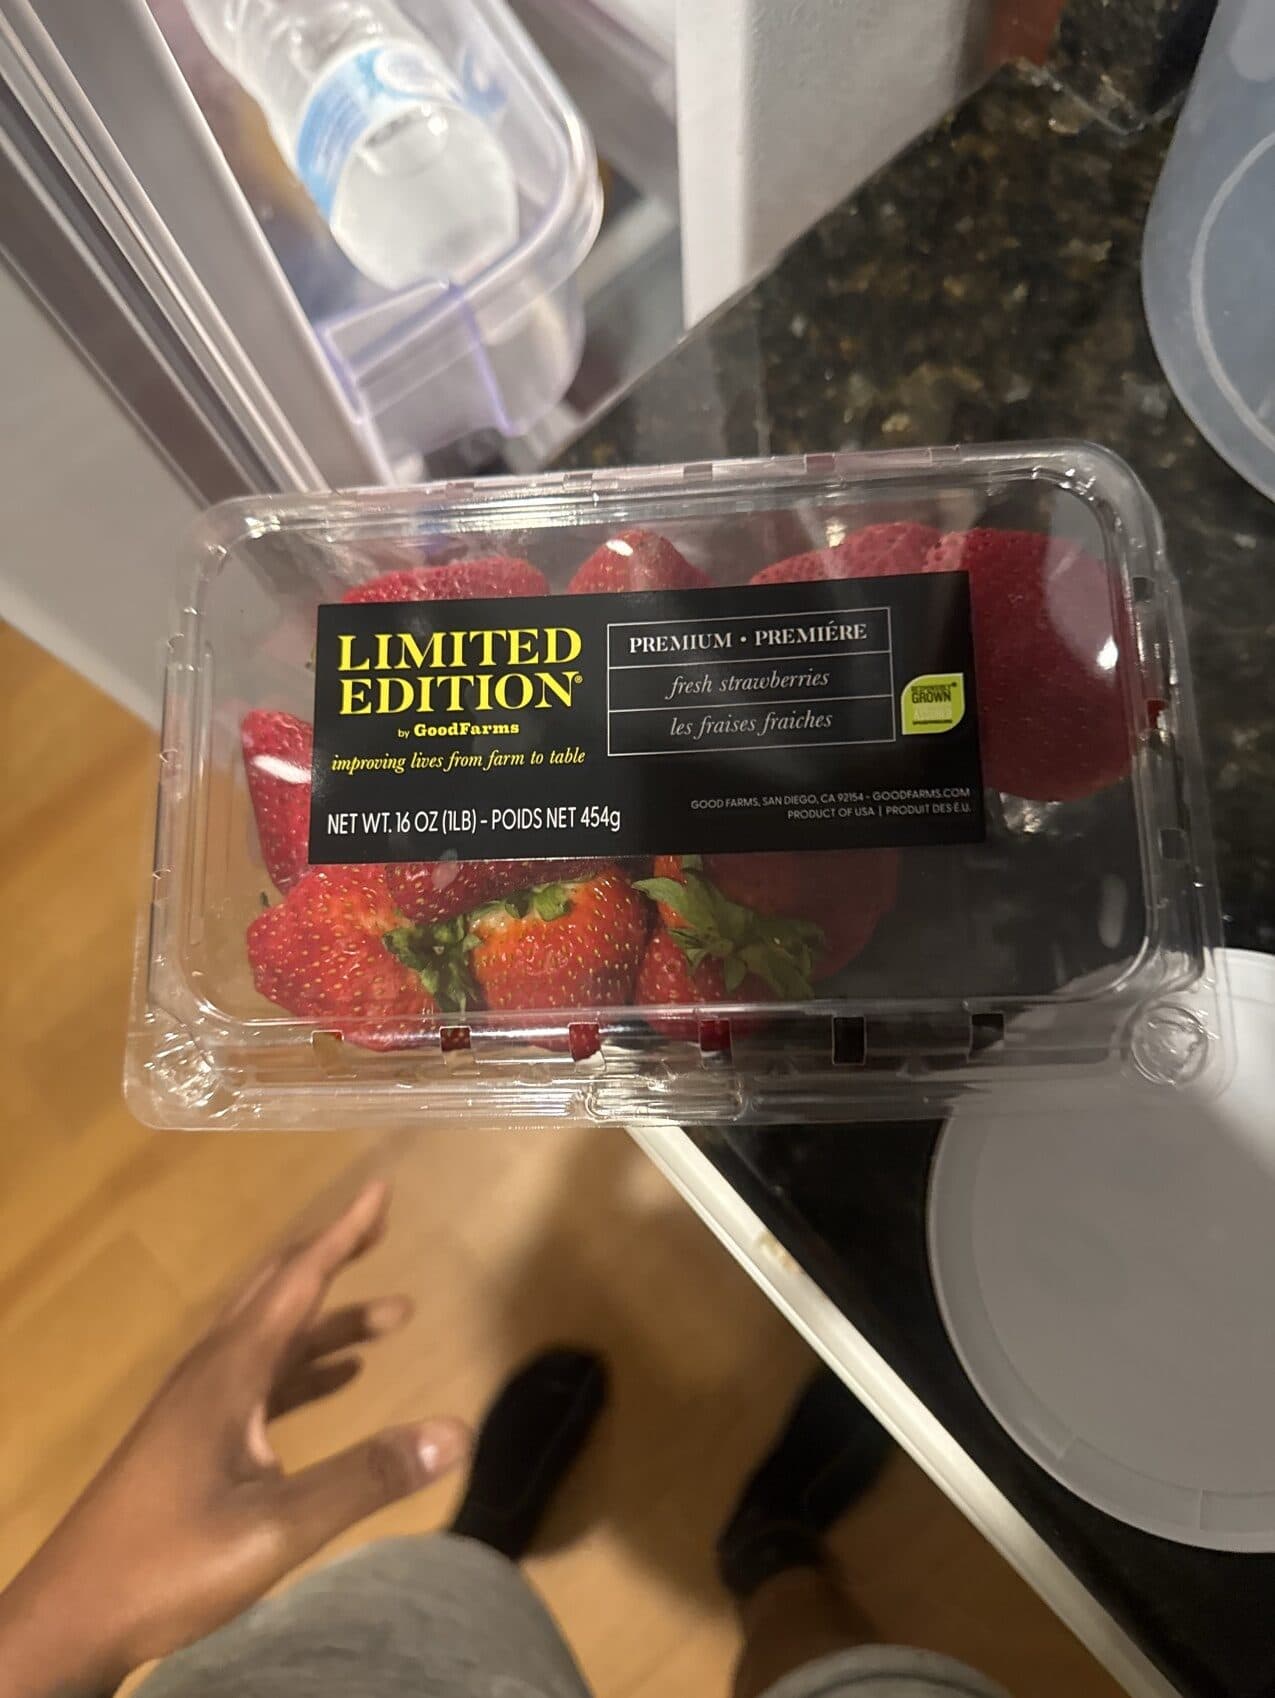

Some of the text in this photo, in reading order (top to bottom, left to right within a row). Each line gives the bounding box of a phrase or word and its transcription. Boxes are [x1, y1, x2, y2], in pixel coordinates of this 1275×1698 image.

[337, 627, 582, 672] LIMITED
[629, 620, 868, 654] PREMIUM PREMIÉRE
[664, 667, 831, 700] fresh strawberries
[911, 691, 952, 704] GROWN
[397, 722, 520, 739] by GoodFarms
[669, 709, 834, 740] les fraises fraiches
[331, 747, 586, 775] improving lives from farm to table
[690, 799, 725, 810] GOOD
[725, 797, 761, 808] FARMS,
[762, 796, 783, 807] SAN
[783, 794, 820, 806] DIEGO,
[820, 793, 836, 804] CA
[837, 791, 865, 803] 92154
[872, 787, 971, 801] GOODFARMS.COM
[787, 807, 836, 820] PRODUCT
[837, 806, 854, 817] OF
[854, 805, 876, 817] USA
[885, 803, 930, 816] PRODUIT
[932, 802, 953, 814] DES
[327, 813, 359, 835] NET
[361, 811, 393, 834] WT.
[395, 811, 411, 834] 16
[414, 810, 440, 833] OZ
[441, 809, 478, 836] (1LB)
[490, 808, 543, 831] POIDS
[546, 806, 578, 829] NET
[580, 805, 622, 833] 454g
